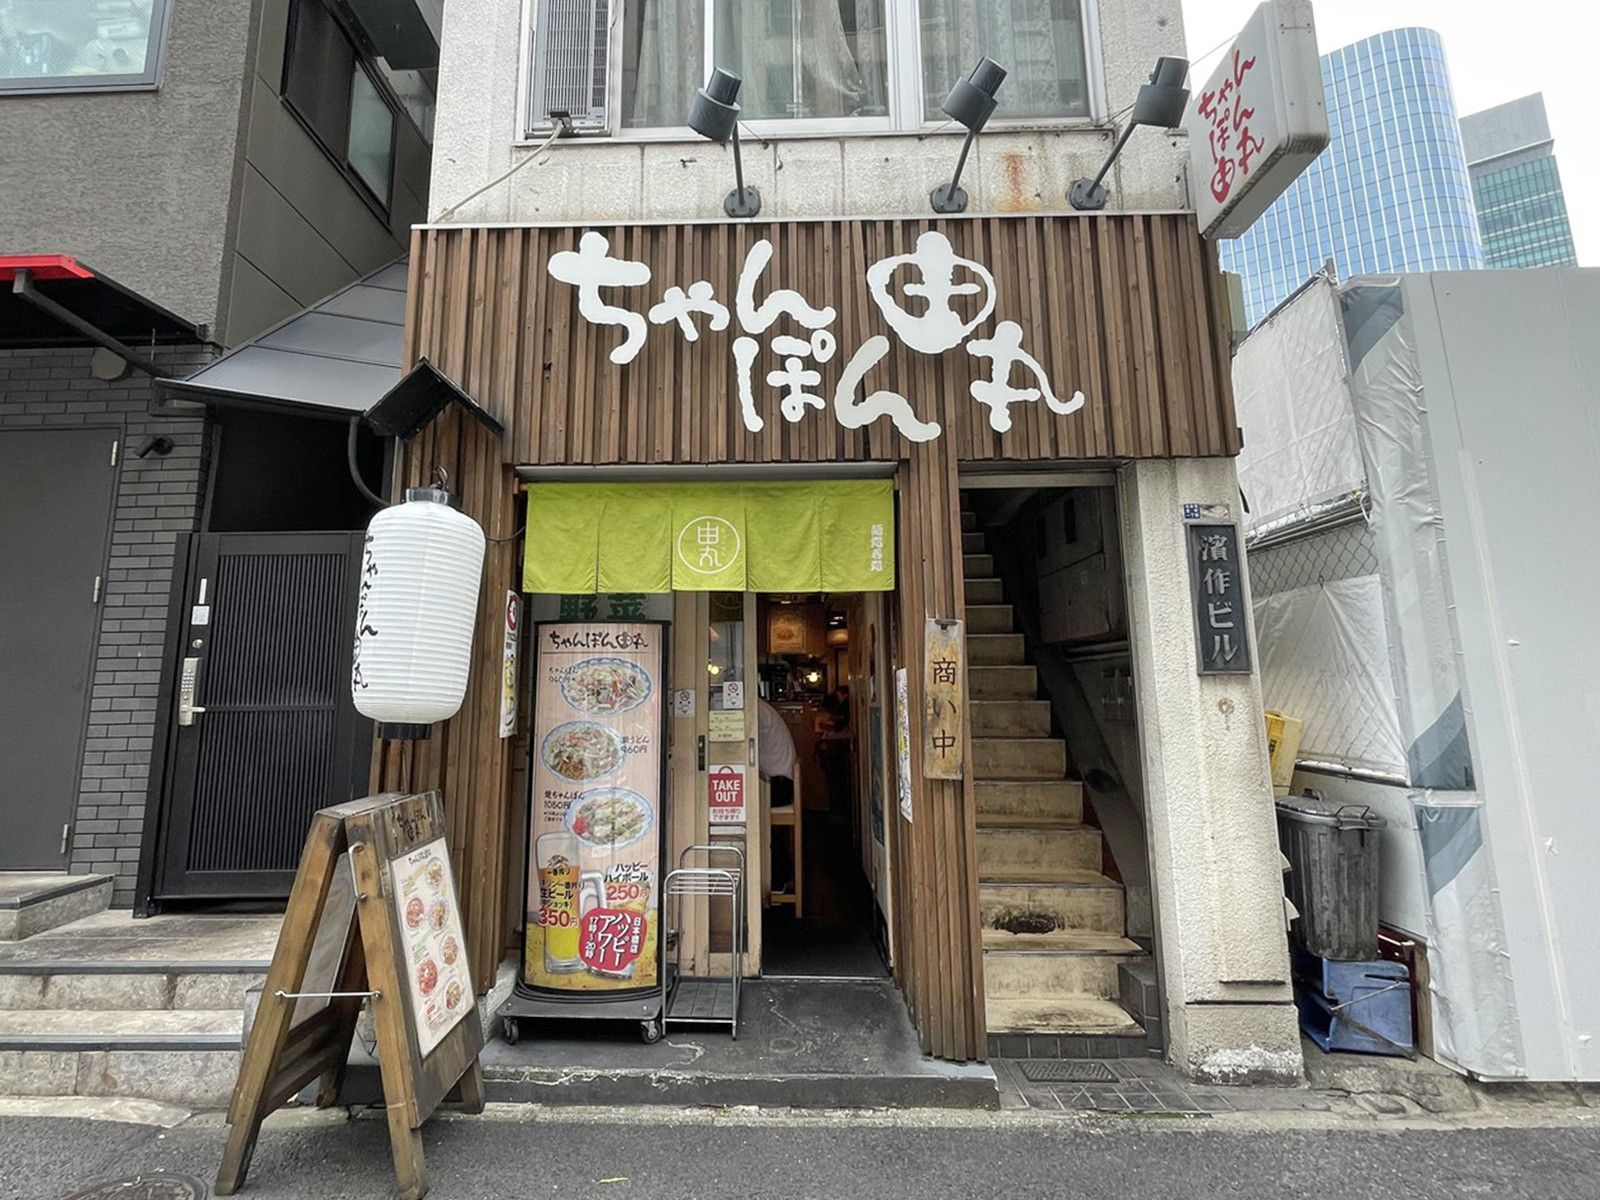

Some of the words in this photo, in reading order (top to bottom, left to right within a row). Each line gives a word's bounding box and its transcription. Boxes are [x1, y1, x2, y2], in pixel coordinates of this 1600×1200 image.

[697, 520, 723, 567] 由丸
[1199, 534, 1239, 662] 濱作ビル
[932, 657, 957, 760] 商い中
[712, 779, 741, 791] TAKE
[715, 791, 738, 803] OUT
[540, 887, 574, 900] 生ビール
[604, 872, 649, 883] ハイボール
[598, 914, 617, 964] アワー
[612, 912, 633, 968] ハッピー
